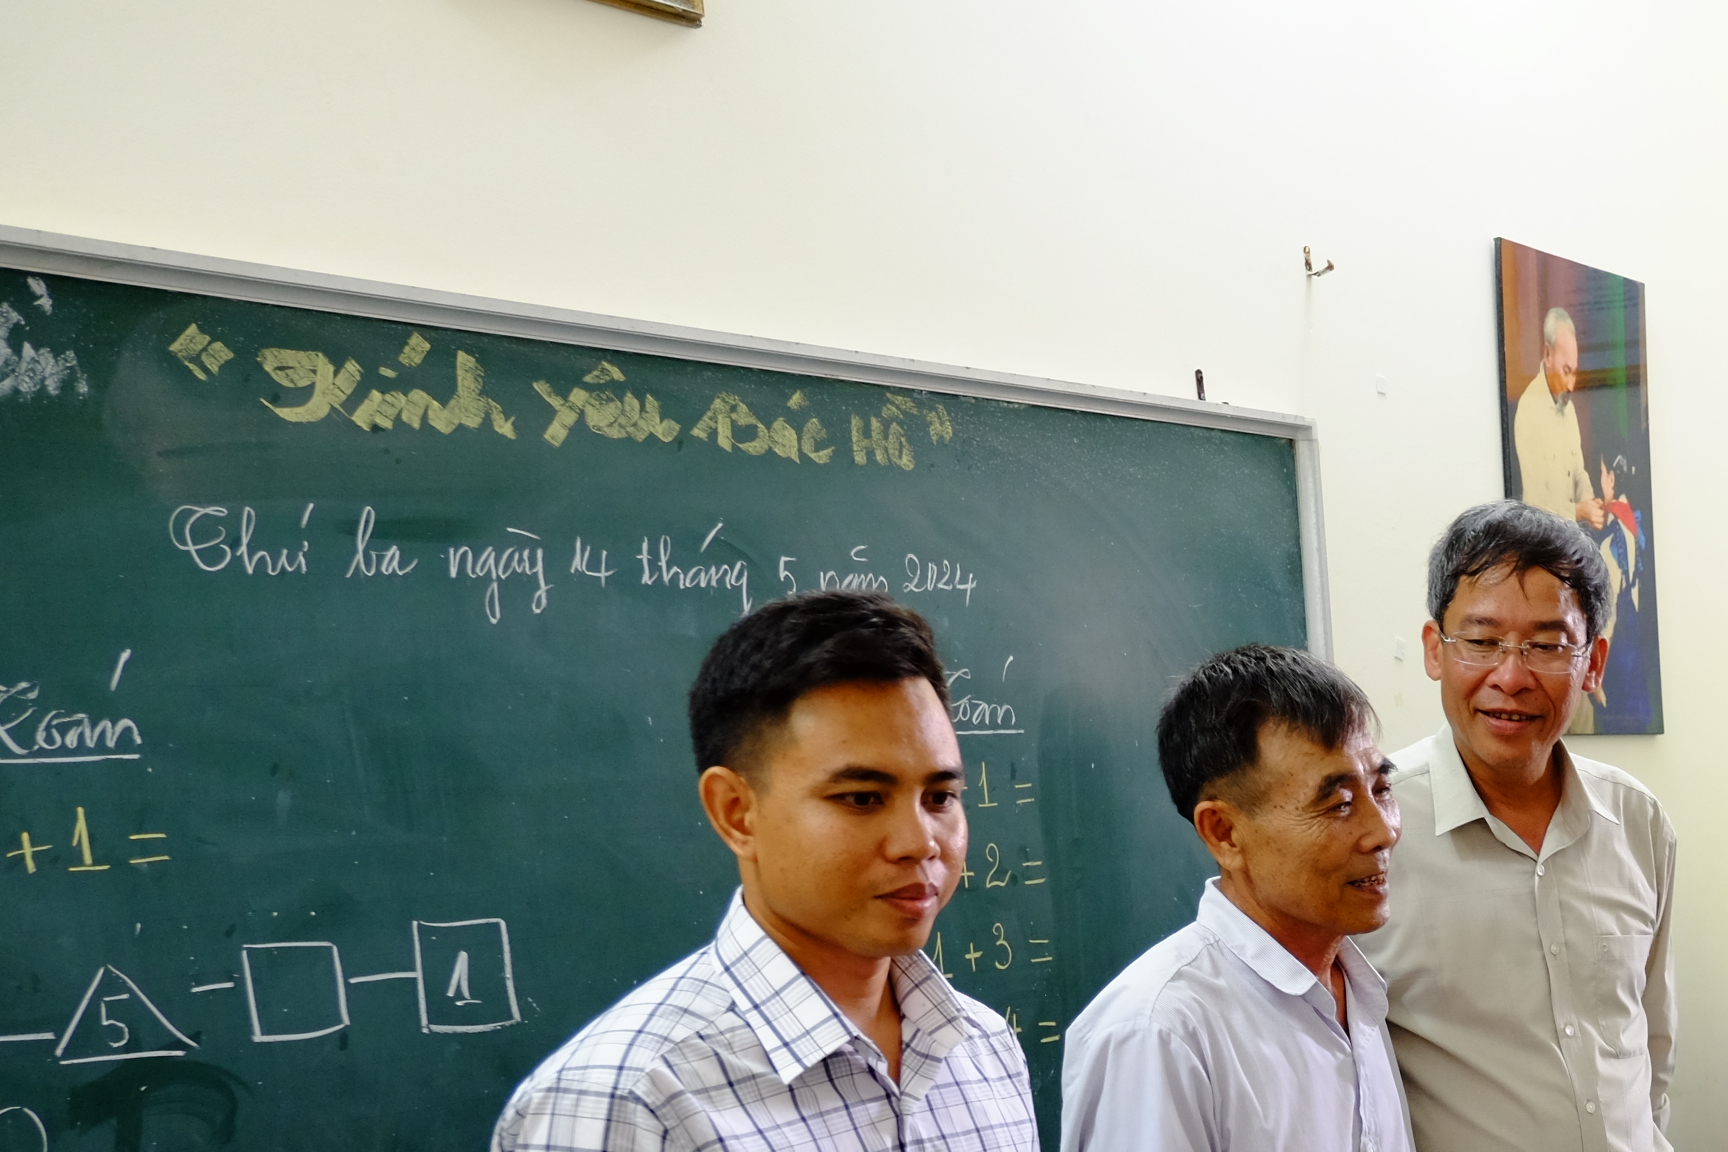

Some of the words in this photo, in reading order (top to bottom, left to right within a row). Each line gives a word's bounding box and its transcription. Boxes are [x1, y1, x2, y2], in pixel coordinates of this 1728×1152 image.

[169, 502, 314, 576] Thứ
[345, 506, 419, 577] ba
[441, 527, 555, 624] ngày
[636, 518, 753, 617] tháng
[779, 555, 797, 595] 5
[903, 553, 977, 607] 2024
[985, 843, 1012, 888] 2
[992, 923, 1012, 970] 3
[102, 994, 130, 1048] 5
